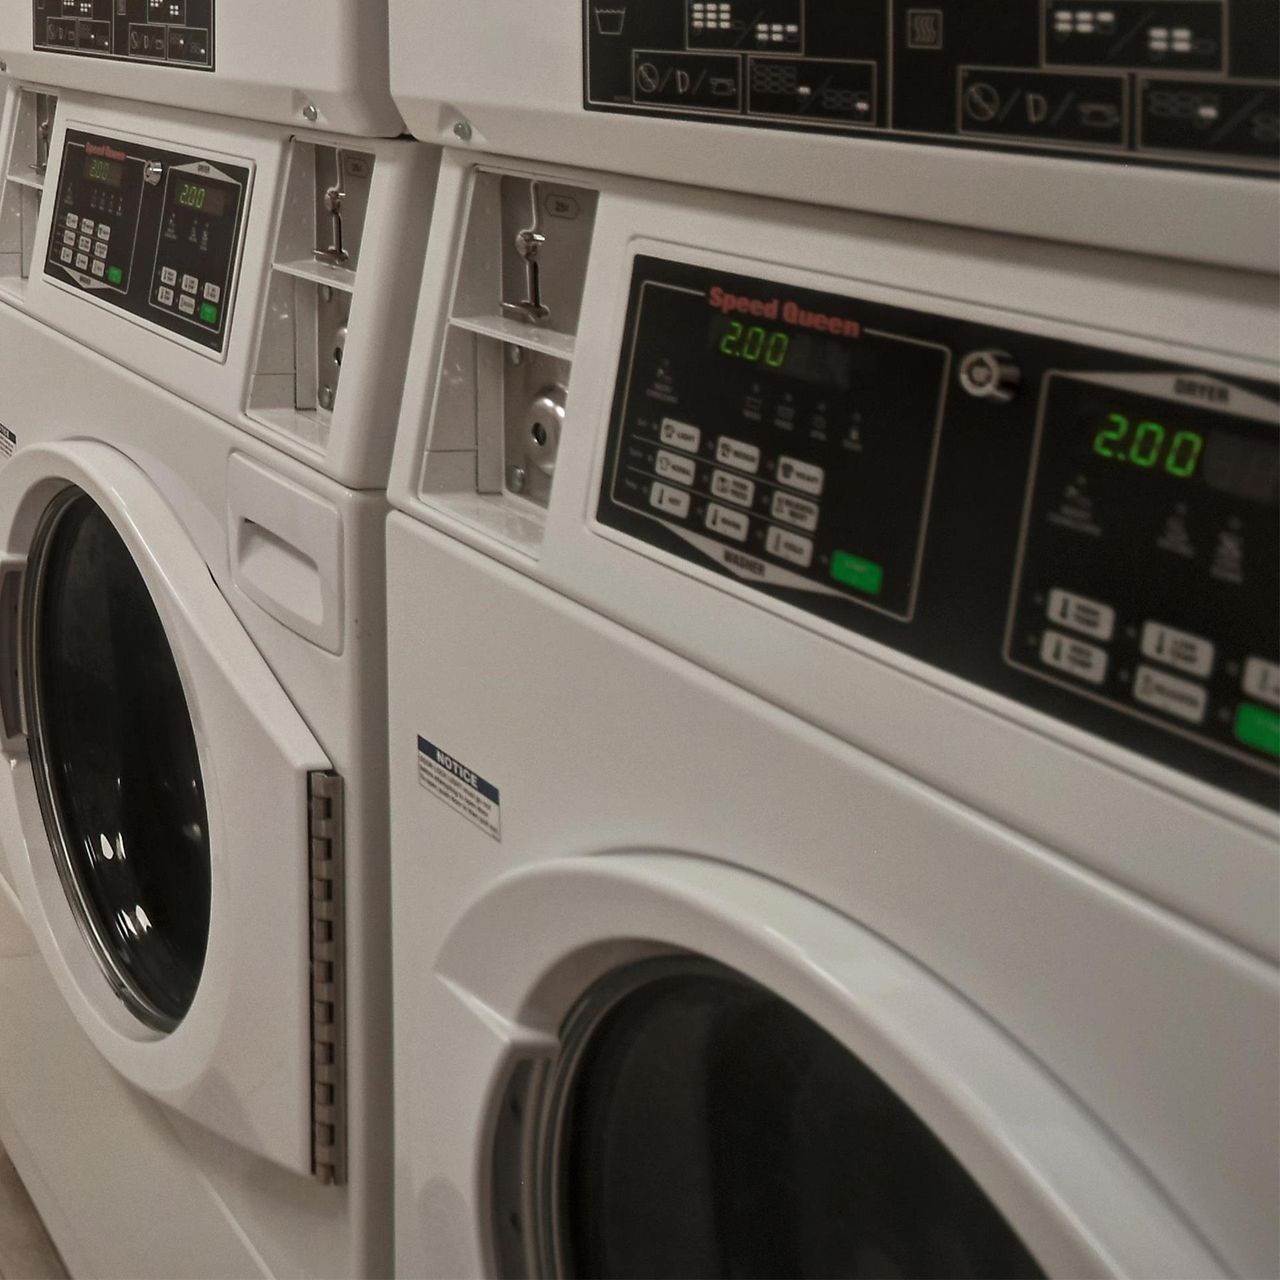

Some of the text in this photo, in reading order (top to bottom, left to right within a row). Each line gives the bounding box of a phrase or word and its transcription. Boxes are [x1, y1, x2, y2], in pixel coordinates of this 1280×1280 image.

[180, 185, 205, 208] 2.00
[709, 286, 862, 339] Speed Queen
[719, 321, 790, 368] 2.00
[1173, 377, 1230, 405] DRYER
[1094, 413, 1204, 479] 2.00
[436, 750, 479, 788] NOTICE
